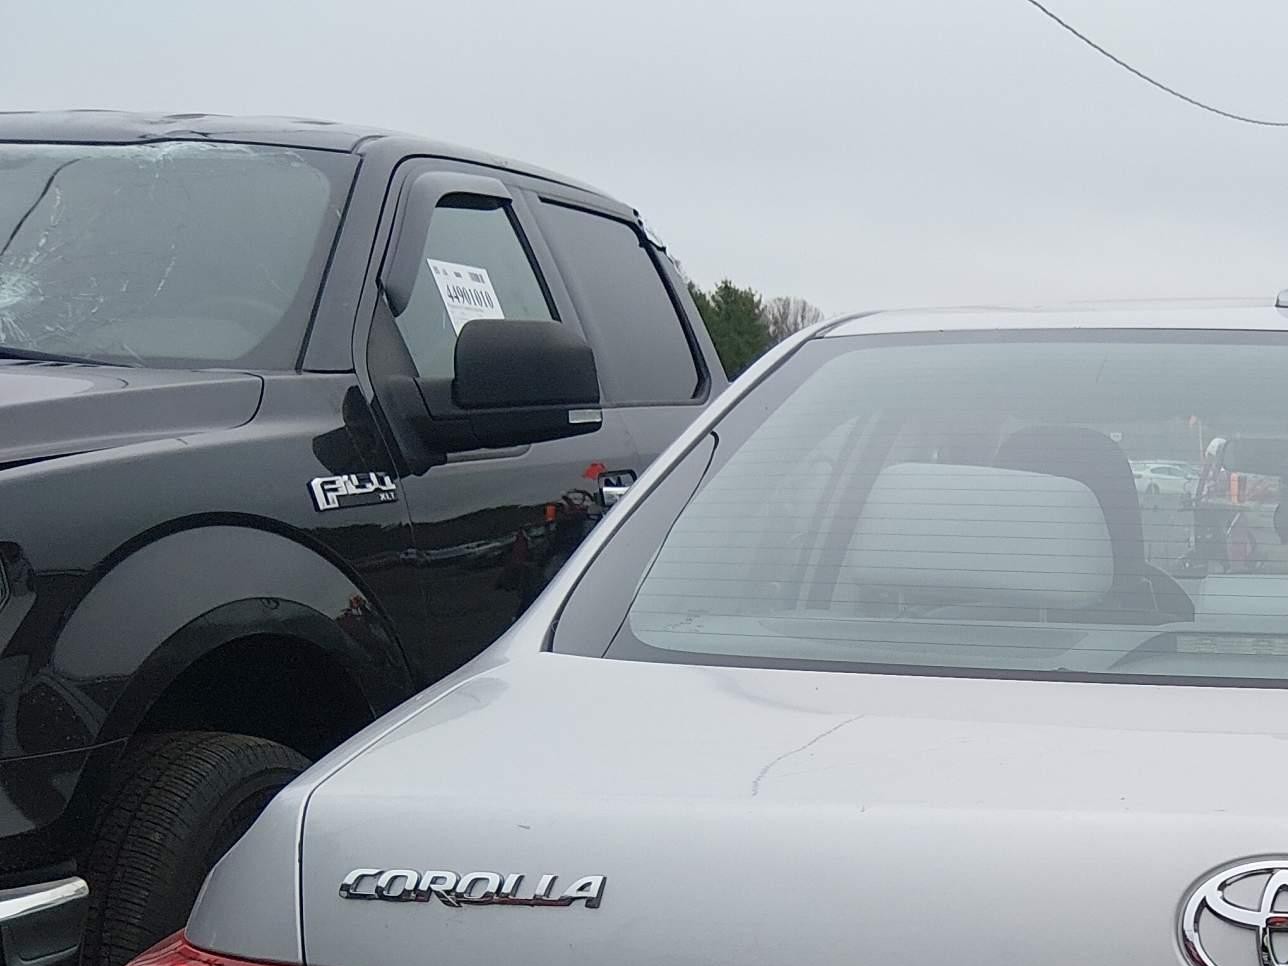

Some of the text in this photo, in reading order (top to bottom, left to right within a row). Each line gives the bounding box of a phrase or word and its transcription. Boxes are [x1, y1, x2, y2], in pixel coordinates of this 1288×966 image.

[446, 283, 494, 309] 44901010
[378, 491, 396, 501] XLT
[339, 867, 607, 908] COROLLA
